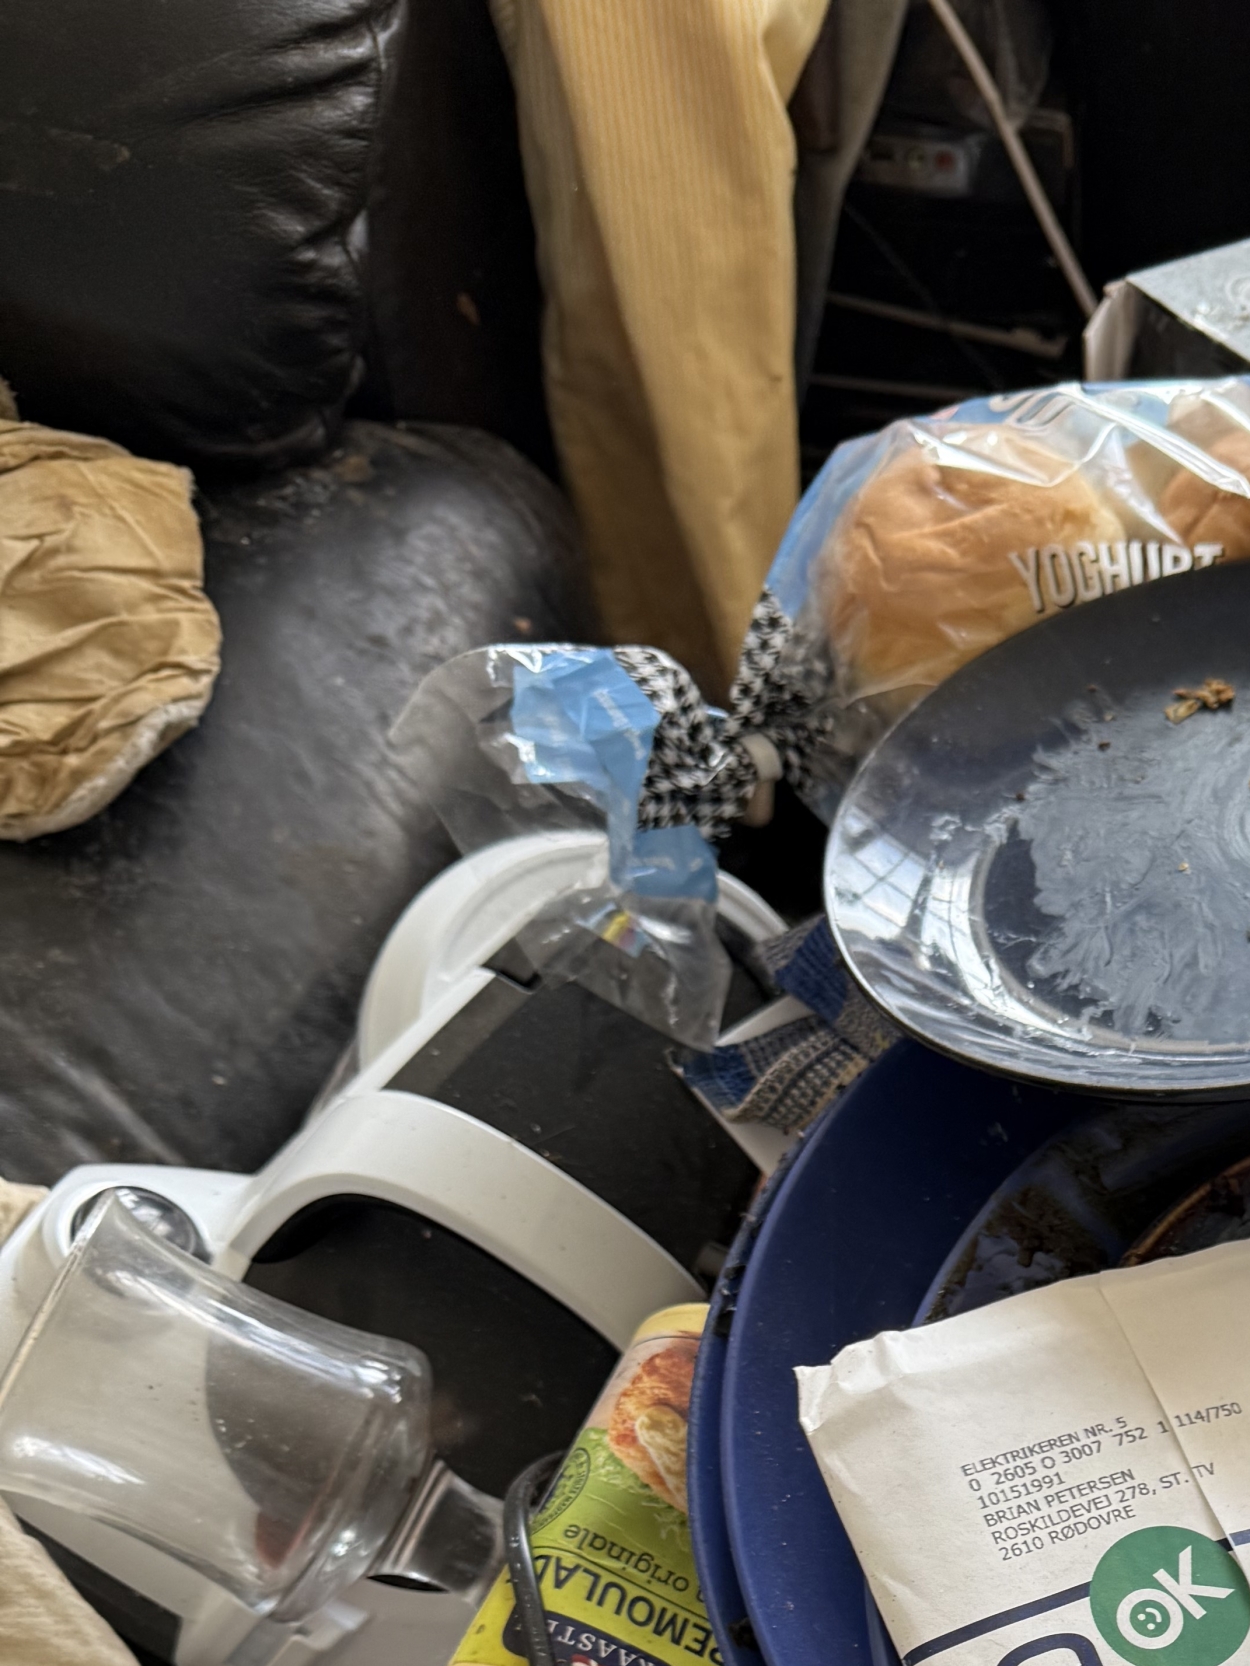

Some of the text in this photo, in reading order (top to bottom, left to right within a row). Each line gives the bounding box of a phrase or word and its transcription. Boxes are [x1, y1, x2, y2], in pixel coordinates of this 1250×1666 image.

[960, 1416, 1128, 1477] ELEKTRIKEREN NR. 5
[991, 1462, 1037, 1486] 2605
[1062, 1440, 1103, 1464] 3007
[1112, 1427, 1148, 1447] 752
[1157, 1421, 1170, 1434] 1
[1174, 1402, 1243, 1428] 114/750
[977, 1472, 1067, 1510] 10151991
[983, 1468, 1136, 1528] BRIAN PETERSEN
[990, 1462, 1216, 1545] ROSKILDEVEJ 278, ST. TV
[564, 1523, 690, 1593] originale
[998, 1504, 1137, 1561] 2610 RØDOVRE
[1116, 1545, 1235, 1650] OK
